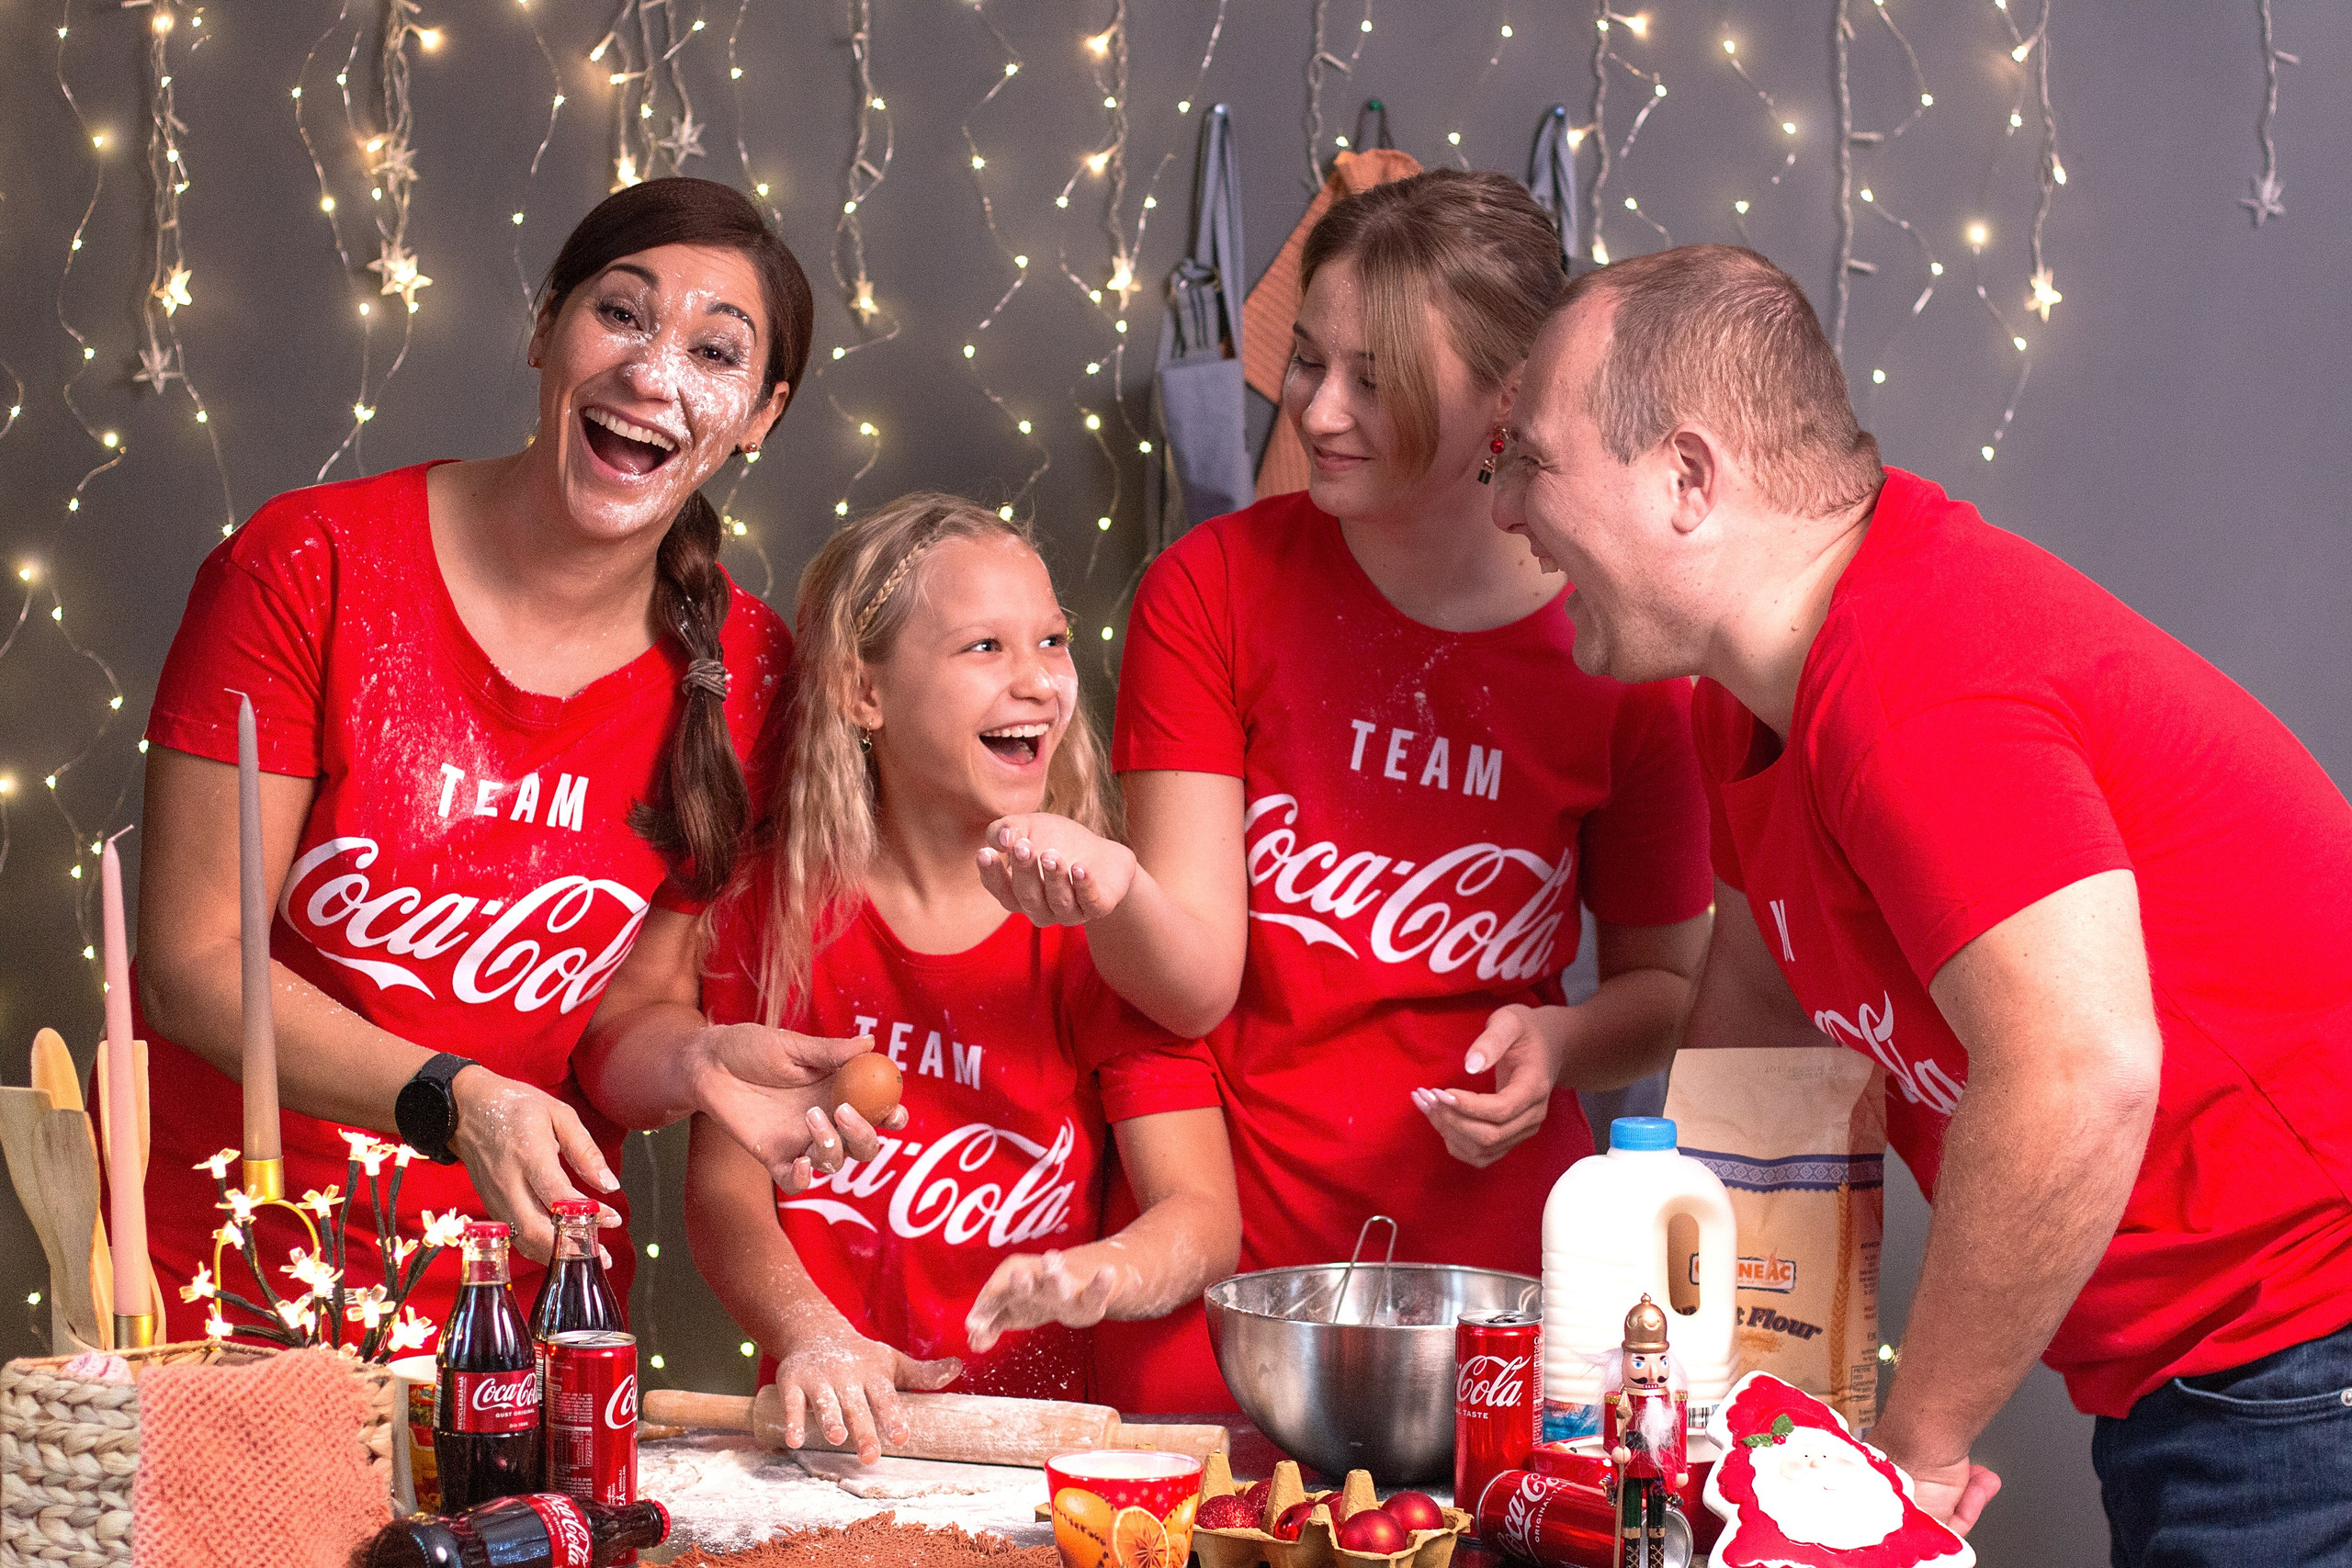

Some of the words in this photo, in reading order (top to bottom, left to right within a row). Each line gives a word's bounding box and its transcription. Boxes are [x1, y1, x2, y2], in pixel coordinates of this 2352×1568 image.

[1351, 718, 1503, 800] TEAM
[436, 763, 589, 831] TEAM
[278, 837, 650, 1014] Coca-Col
[1747, 1305, 1823, 1340] Flour
[472, 1372, 538, 1411] Coca-Col
[1463, 1409, 1488, 1419] TASTE
[1534, 1495, 1553, 1543] ORIGINAL
